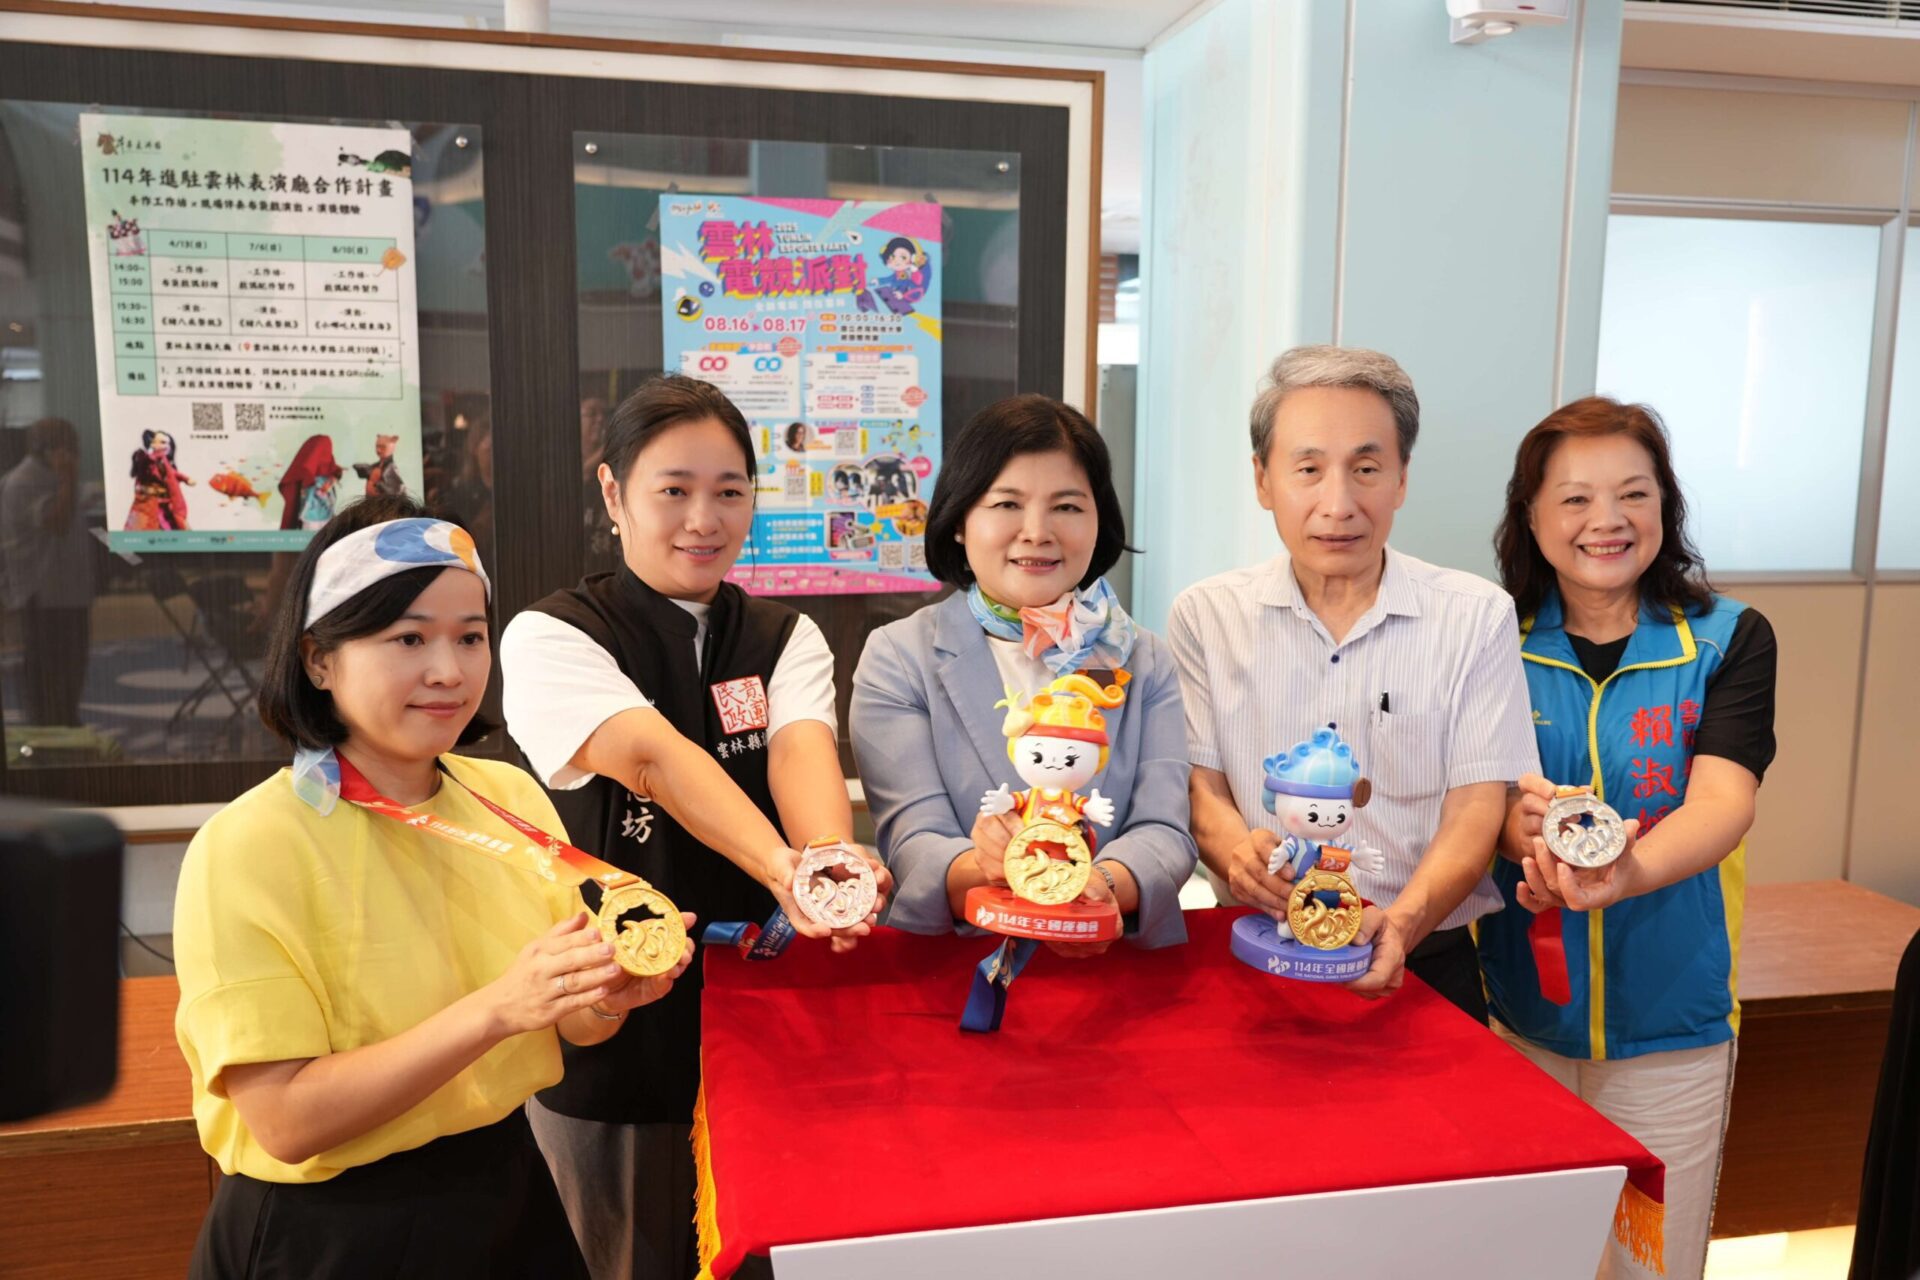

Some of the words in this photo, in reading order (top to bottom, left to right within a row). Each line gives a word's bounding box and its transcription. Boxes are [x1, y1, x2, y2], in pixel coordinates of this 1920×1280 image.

[102, 167, 394, 198] 114年進駐雲林表演廳合作計畫
[698, 220, 776, 264] 雲林
[716, 253, 868, 299] 電競派對
[705, 317, 749, 331] 08.16
[763, 318, 806, 332] 08.17
